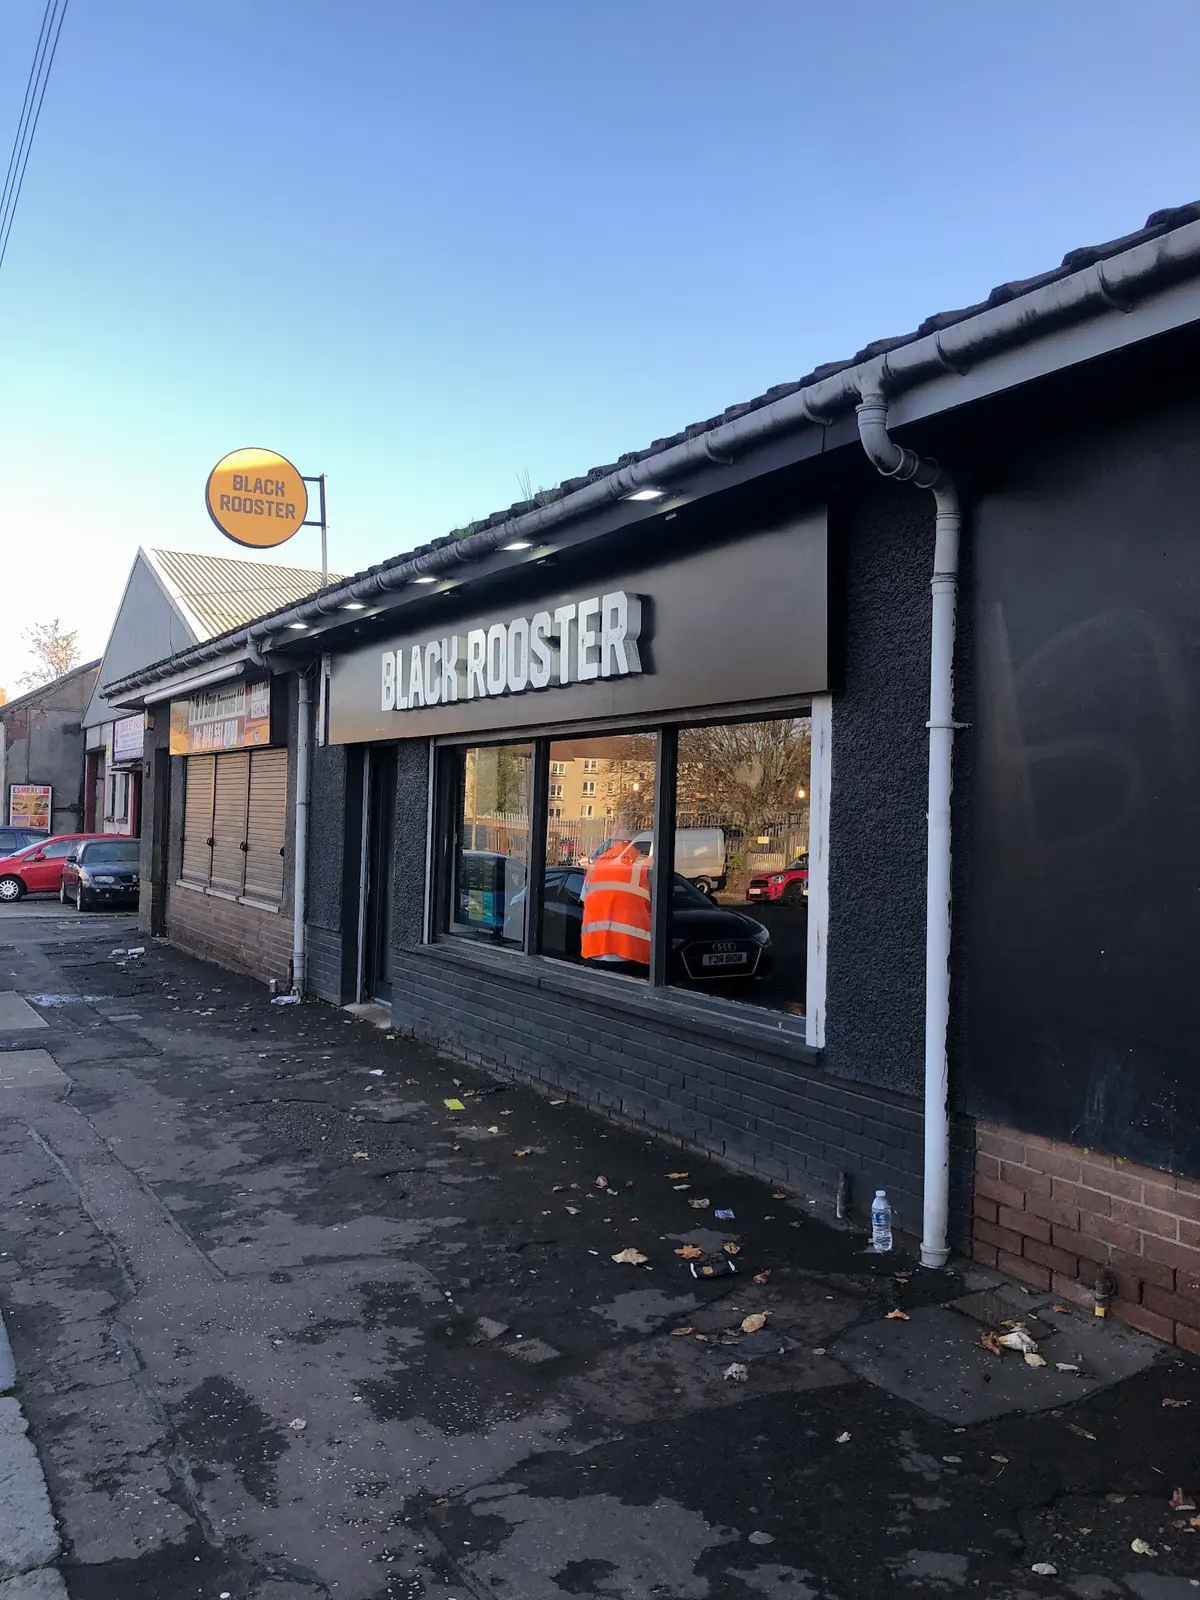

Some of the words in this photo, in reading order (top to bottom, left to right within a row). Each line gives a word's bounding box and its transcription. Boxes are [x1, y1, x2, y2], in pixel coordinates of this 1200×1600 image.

[233, 474, 285, 498] BLACK
[220, 494, 296, 520] ROOSTER
[381, 634, 458, 711] BLACK
[467, 590, 635, 700] ROOSTER
